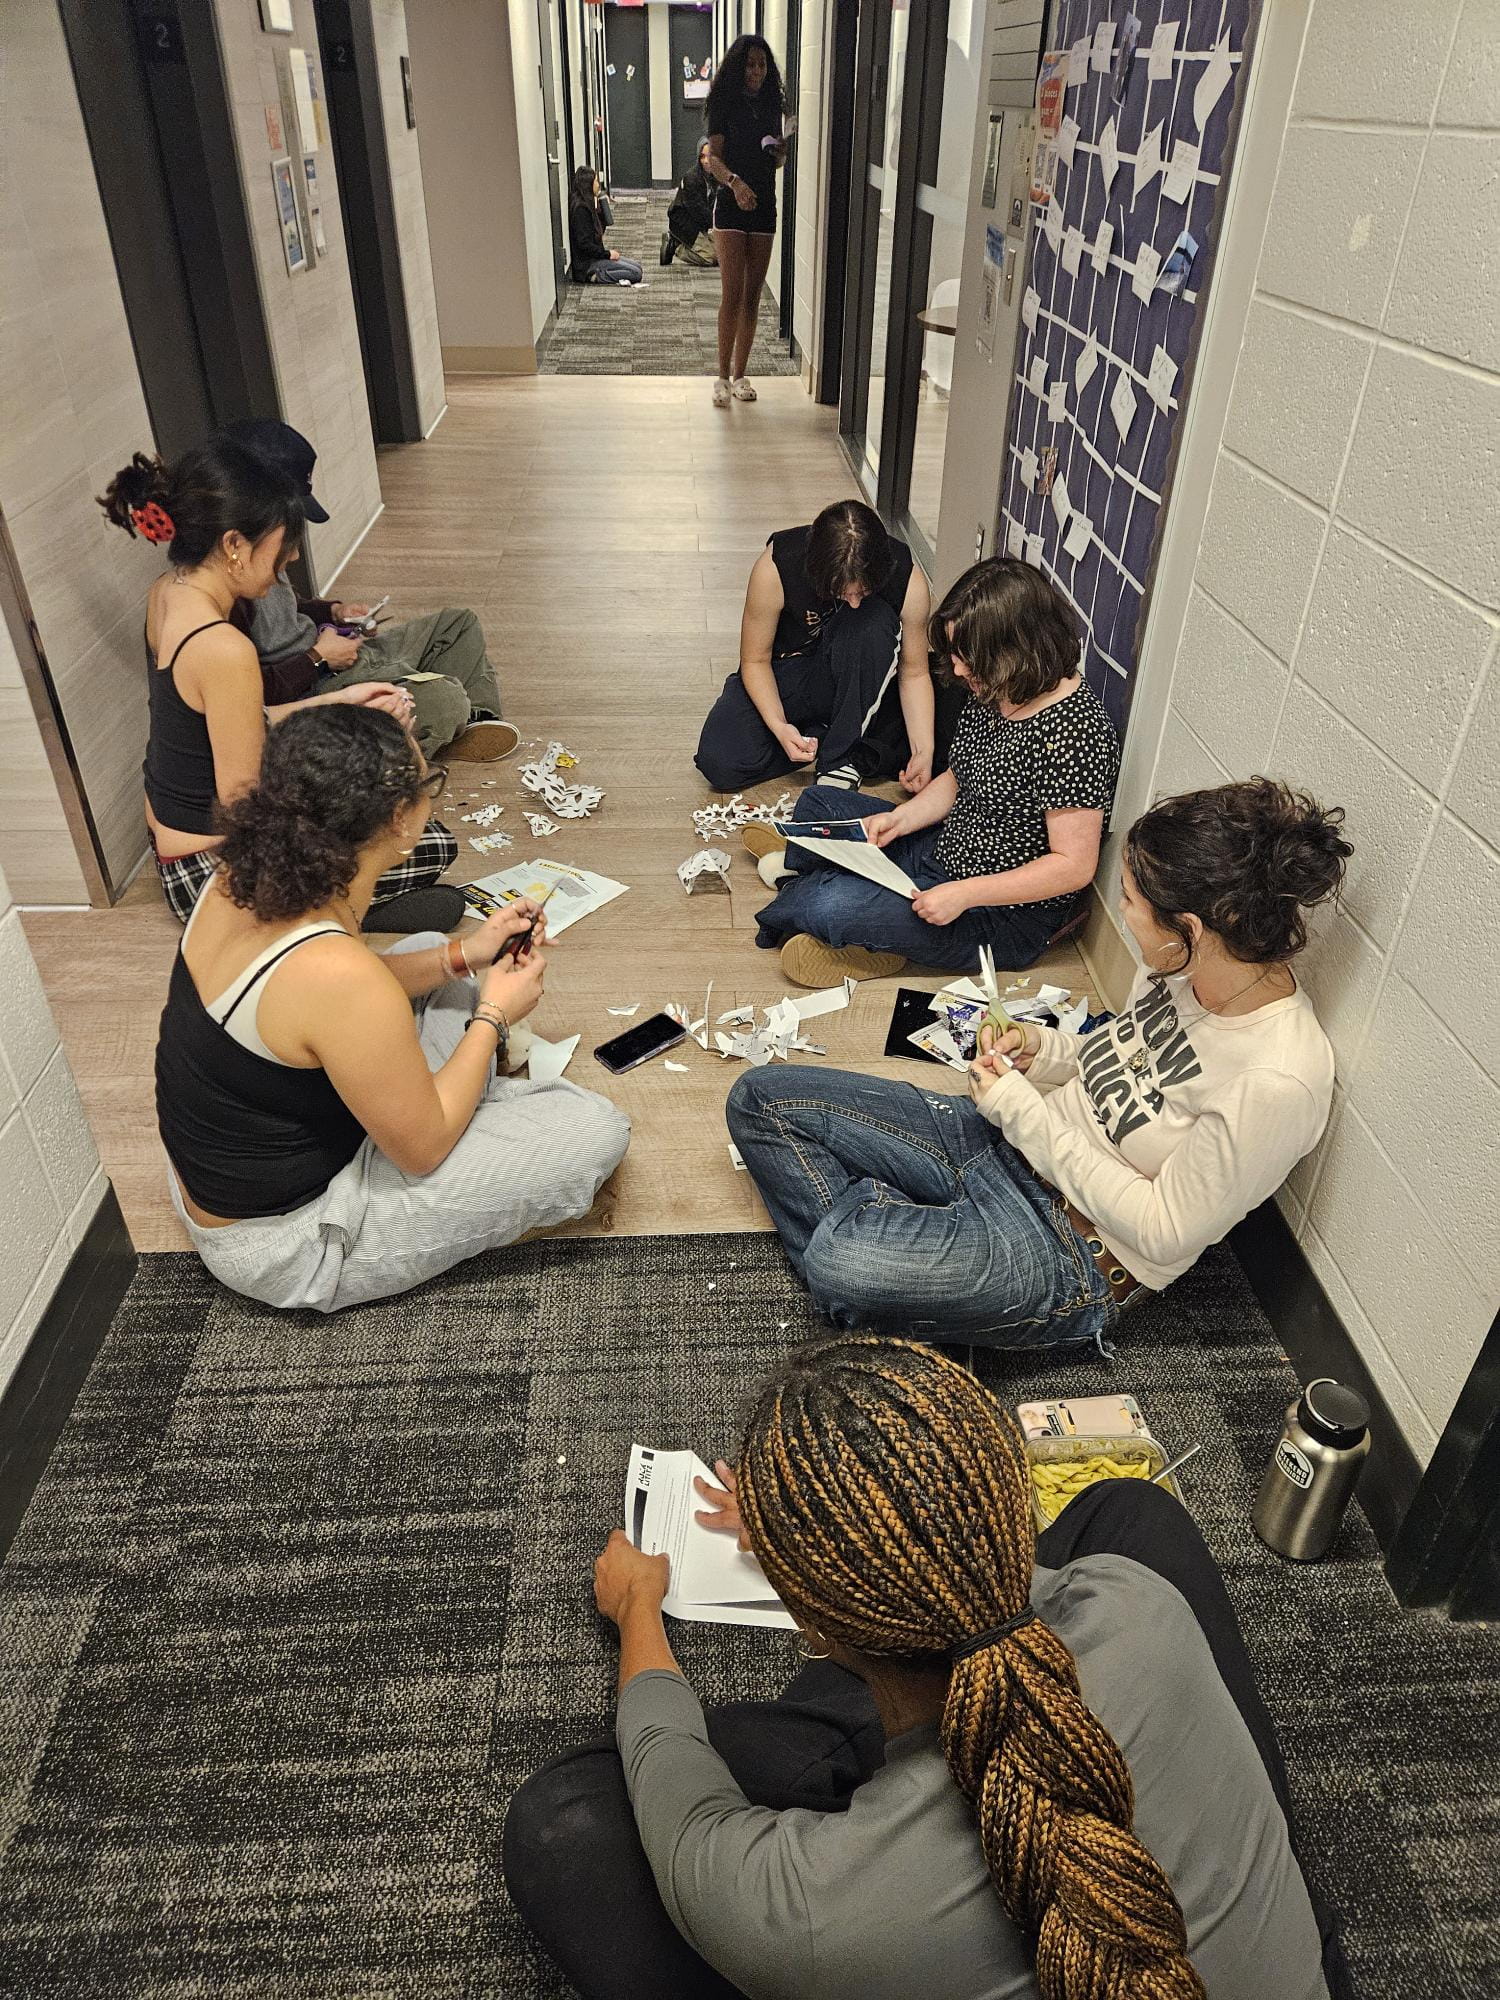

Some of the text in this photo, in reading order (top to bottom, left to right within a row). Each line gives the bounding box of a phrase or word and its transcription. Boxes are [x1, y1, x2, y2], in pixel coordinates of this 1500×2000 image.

[155, 22, 171, 48] 2
[336, 46, 346, 63] 2
[1134, 978, 1203, 1089] HOW
[1116, 1010, 1136, 1045] TO
[1142, 1086, 1165, 1116] A
[1279, 1448, 1308, 1479] WEEKEND
